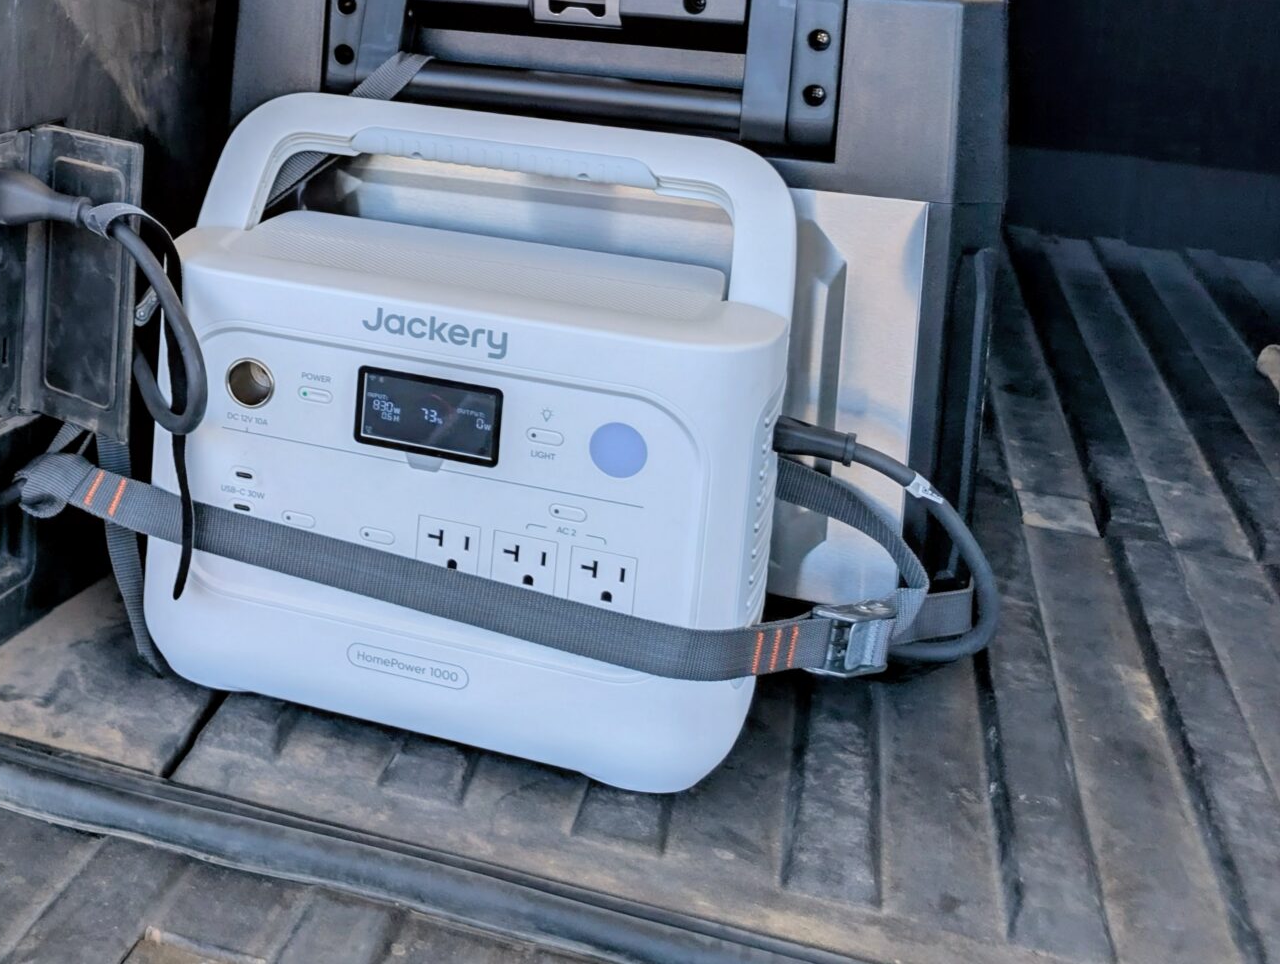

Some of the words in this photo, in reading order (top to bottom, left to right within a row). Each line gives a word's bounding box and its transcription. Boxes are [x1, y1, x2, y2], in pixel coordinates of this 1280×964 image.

[362, 307, 508, 359] Jackery
[301, 372, 332, 383] POWER
[227, 412, 239, 420] DC
[241, 414, 253, 423] 12V
[255, 417, 268, 425] 10A
[530, 449, 556, 460] LIGHT
[220, 484, 246, 496] USB-C
[247, 489, 265, 499] 30W
[556, 526, 569, 535] AC
[356, 651, 426, 675] HomePower
[430, 667, 459, 682] 1000
